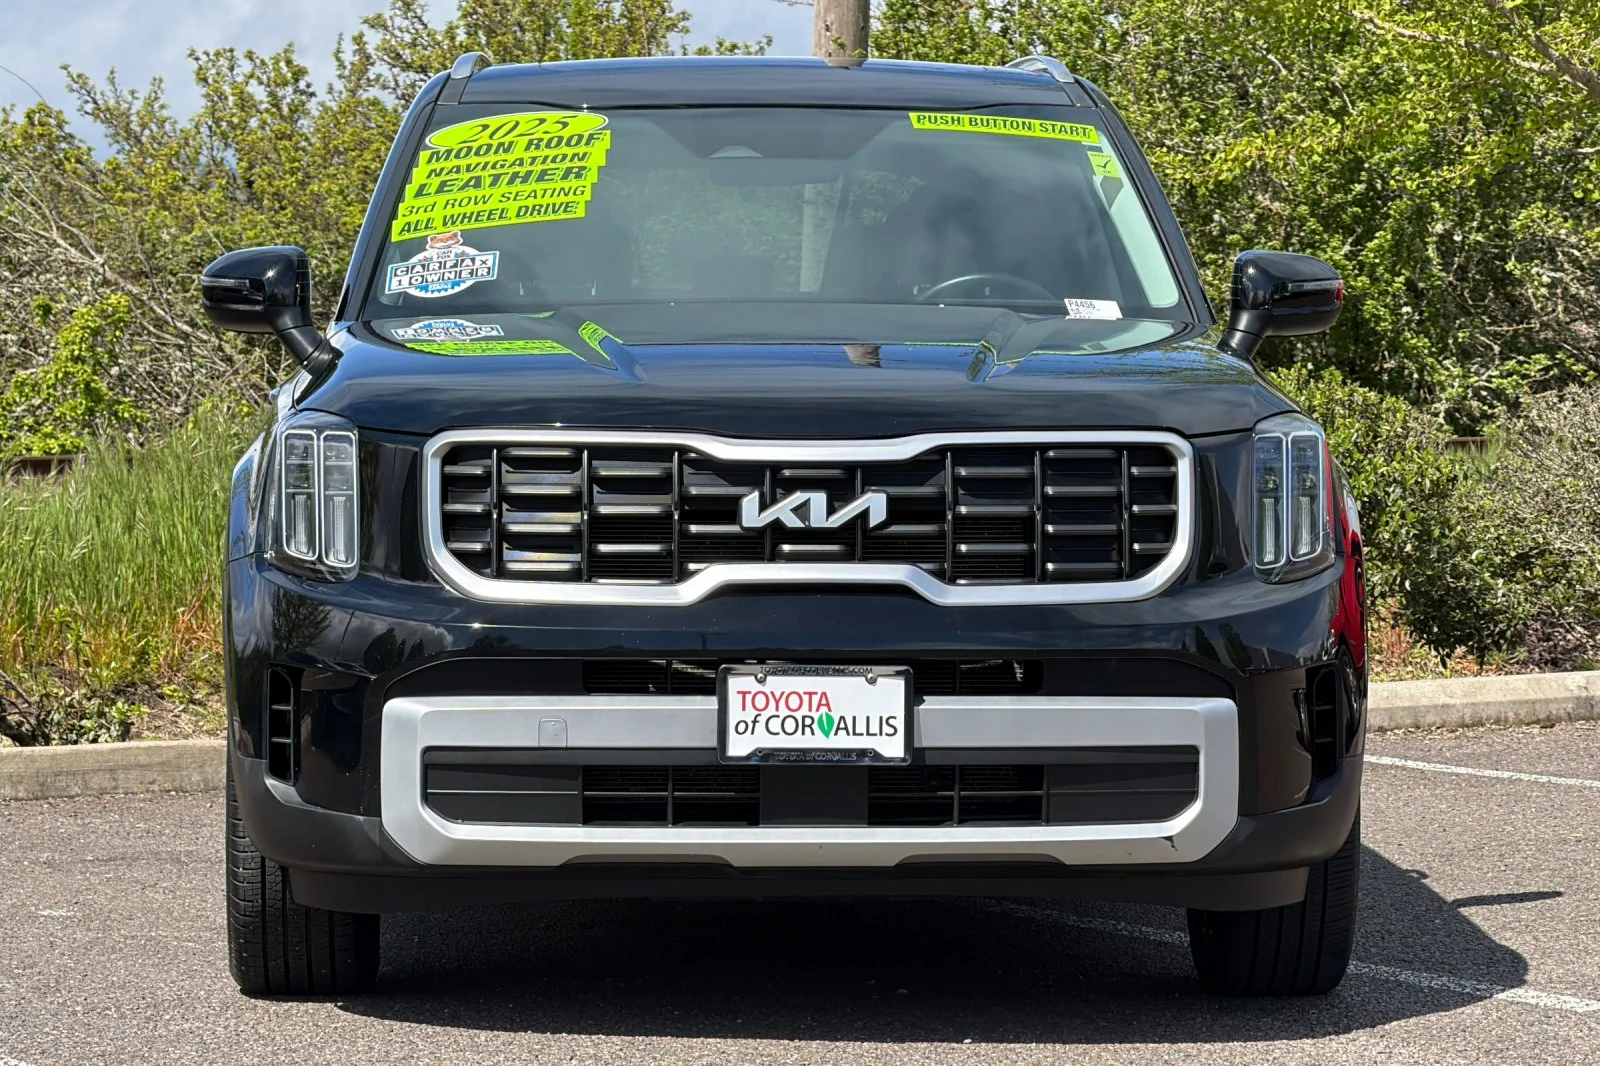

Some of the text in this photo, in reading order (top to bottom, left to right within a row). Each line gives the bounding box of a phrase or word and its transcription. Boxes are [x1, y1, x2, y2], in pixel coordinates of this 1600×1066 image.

[456, 115, 578, 145] 2025
[917, 115, 1092, 139] PUSH BUTTON START
[426, 131, 606, 165] MOON ROOF
[426, 152, 592, 179] NAVIGATION
[413, 165, 592, 198] LEATHER
[401, 185, 586, 217] 3rd ROW SEATING
[398, 201, 579, 236] ALL WHEEL DRIVE
[395, 258, 490, 277] CARFAX
[410, 268, 488, 284] OWNER
[742, 490, 887, 528] KIA
[737, 691, 832, 713] TOYOTA
[734, 713, 761, 736] of
